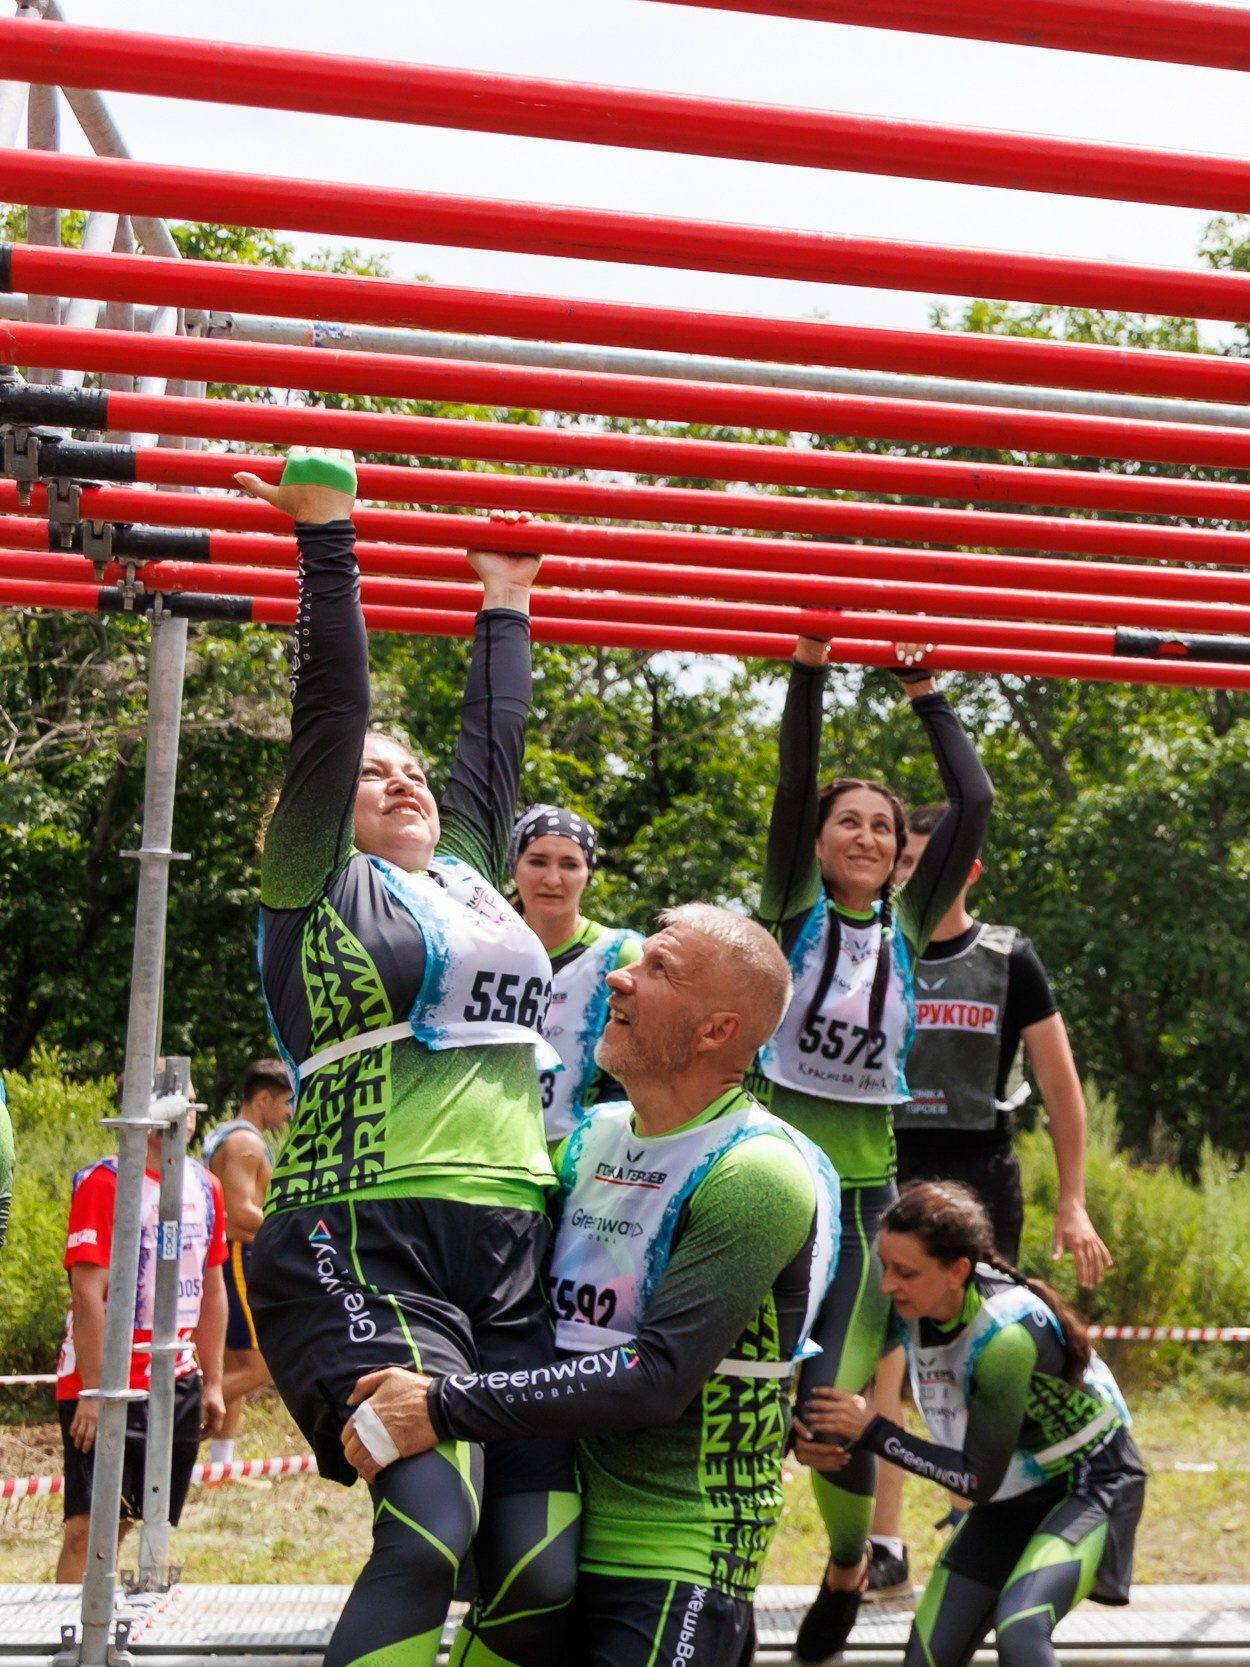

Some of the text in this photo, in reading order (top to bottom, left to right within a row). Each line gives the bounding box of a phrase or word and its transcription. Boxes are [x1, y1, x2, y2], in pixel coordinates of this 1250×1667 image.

[302, 592, 312, 661] GLOBAL
[916, 1003, 994, 1029] РУКТОР
[798, 1014, 887, 1070] 5572
[449, 1349, 619, 1392] Greenway
[505, 1382, 588, 1404] GLOBAL
